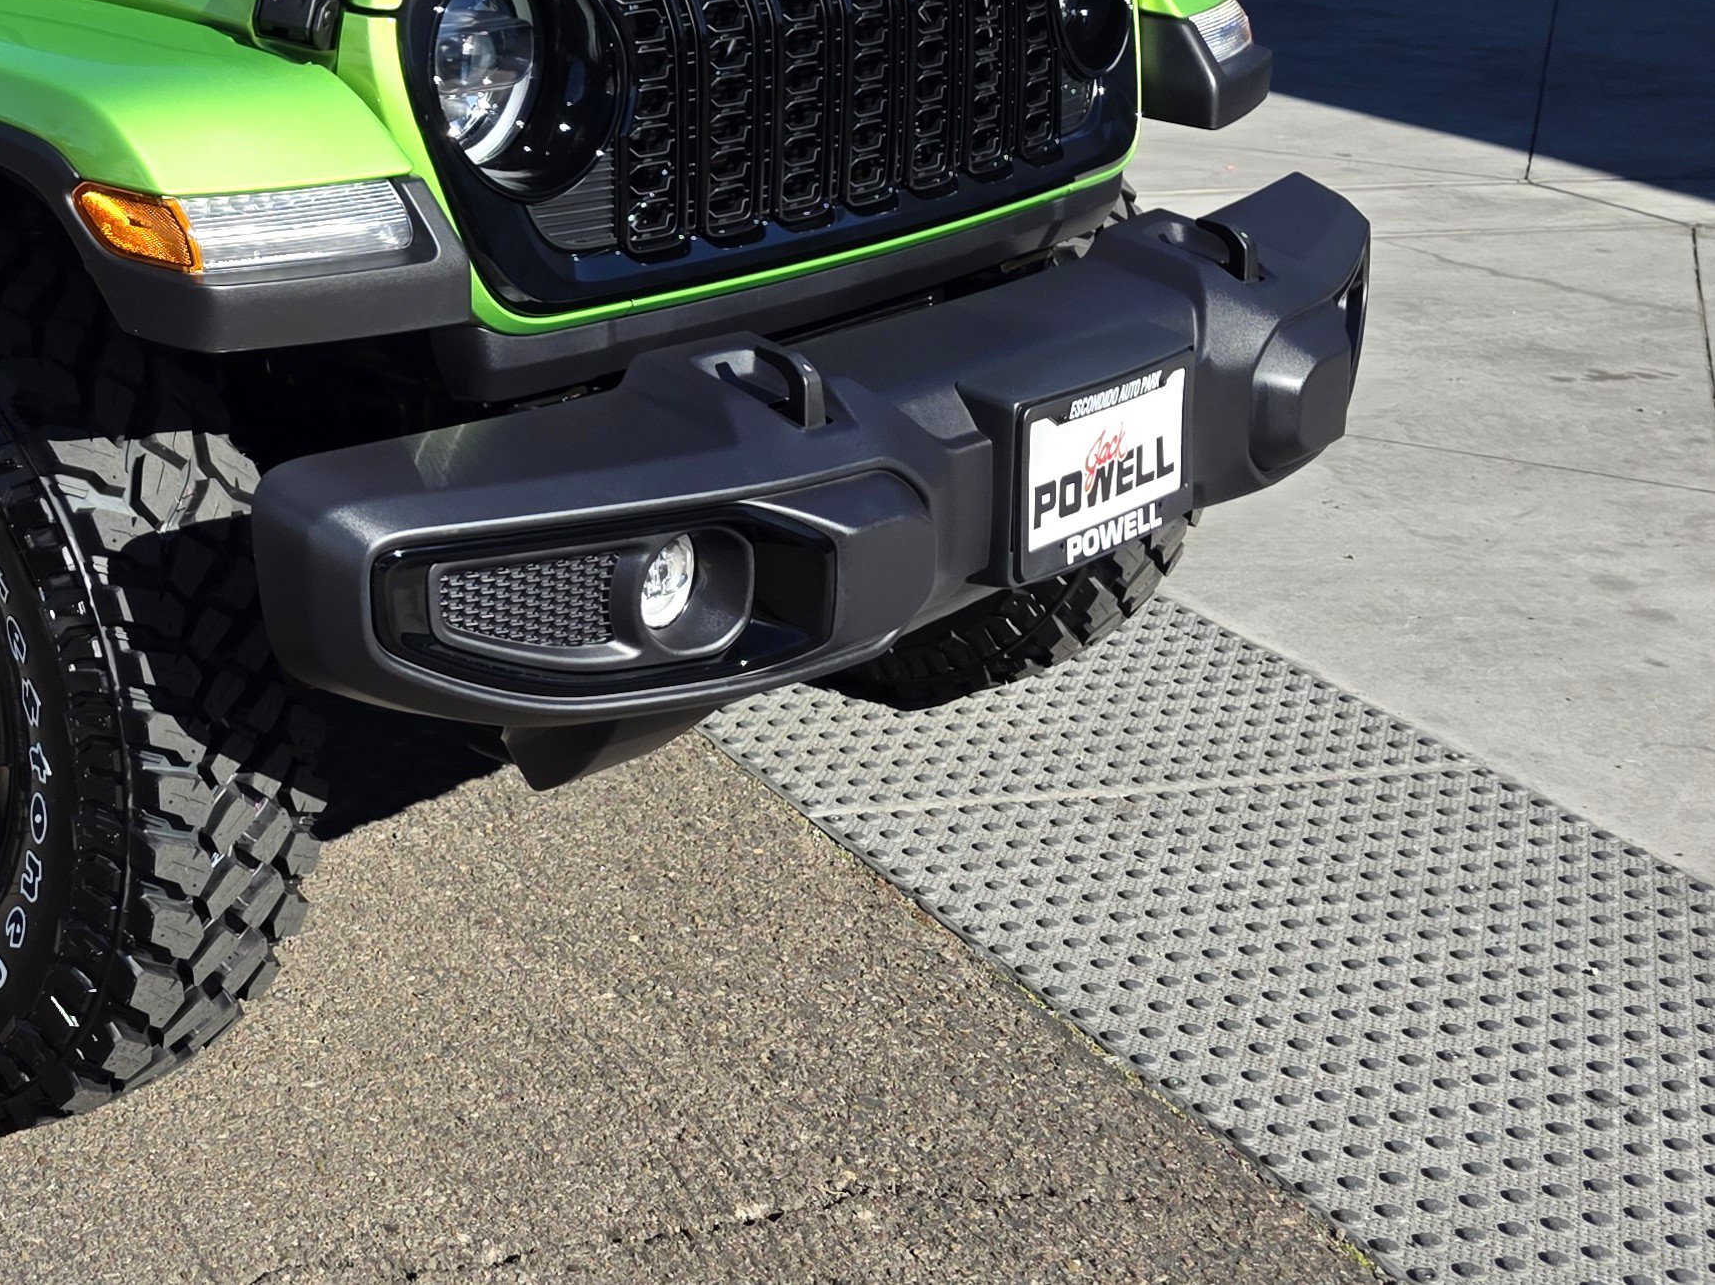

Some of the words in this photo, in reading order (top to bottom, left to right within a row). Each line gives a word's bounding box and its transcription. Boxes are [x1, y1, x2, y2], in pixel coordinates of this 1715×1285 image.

[1069, 386, 1121, 420] ESCONDIDO
[1118, 378, 1142, 404] AUTO
[1139, 369, 1163, 395] PARK
[1034, 435, 1174, 530] POWELL
[1084, 421, 1127, 492] Jack
[1066, 502, 1163, 565] POWELL
